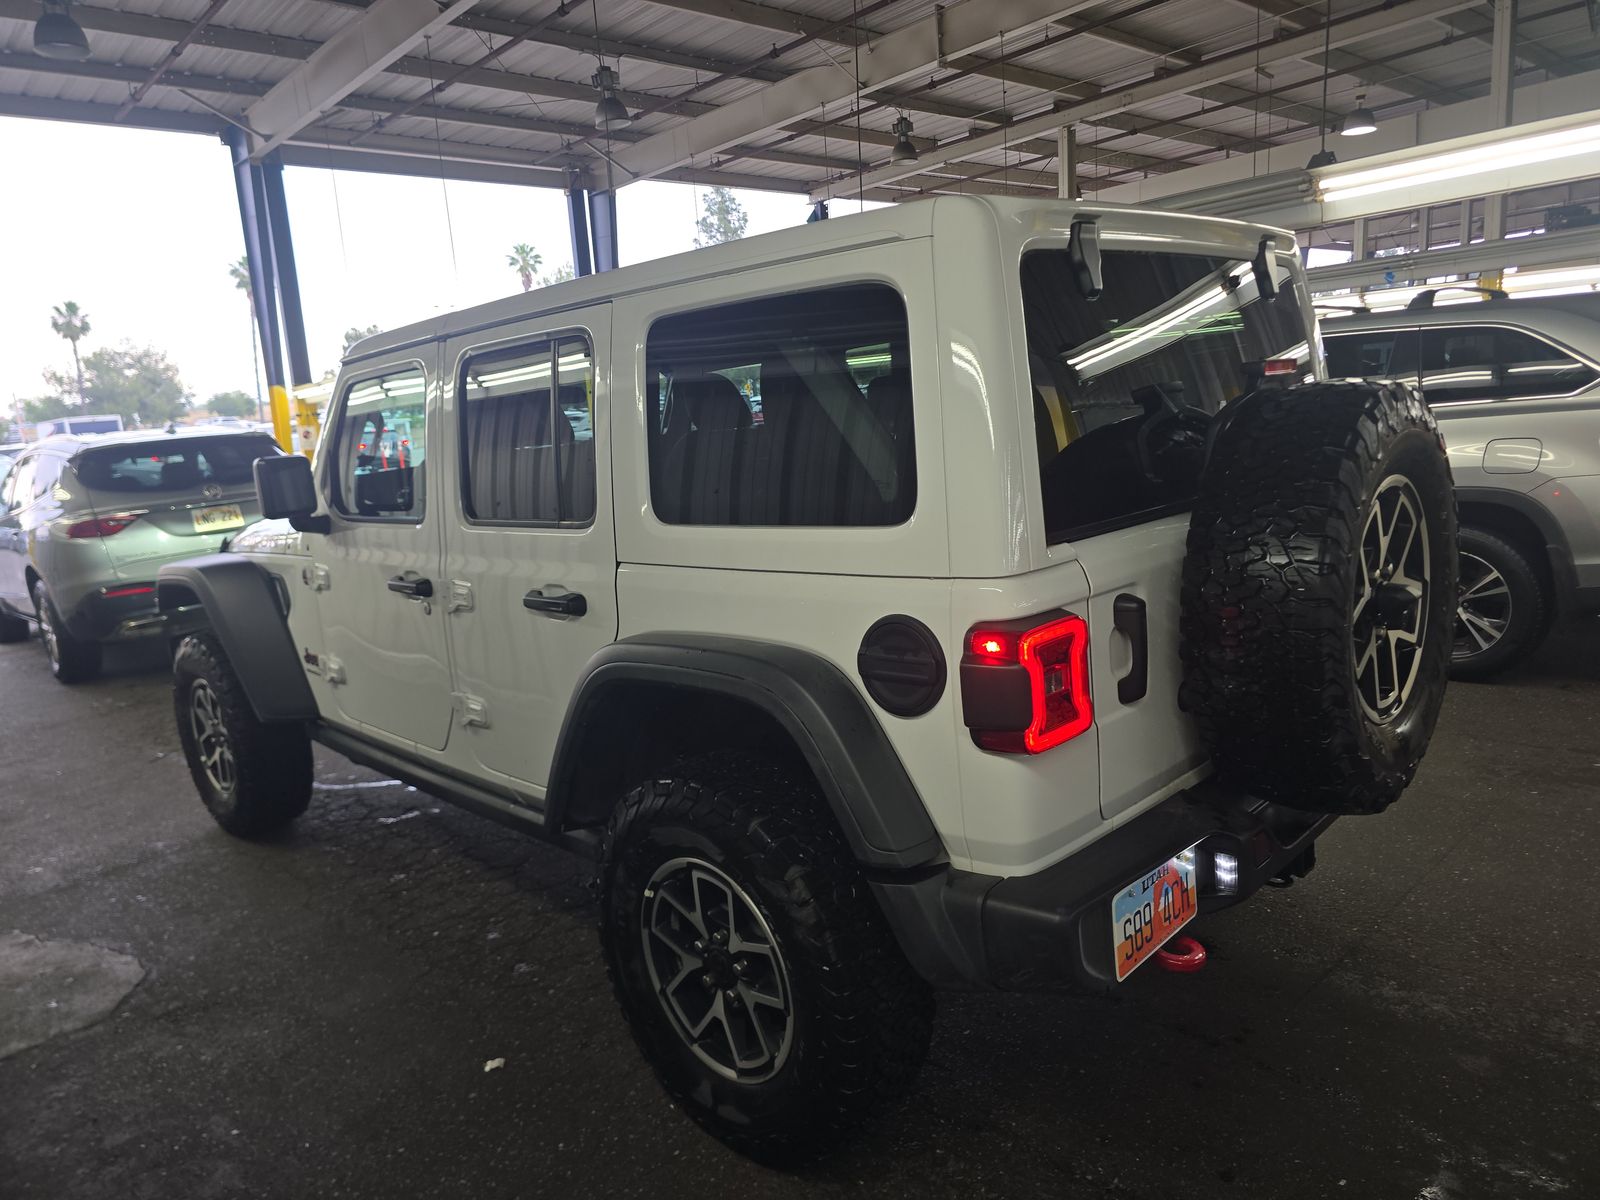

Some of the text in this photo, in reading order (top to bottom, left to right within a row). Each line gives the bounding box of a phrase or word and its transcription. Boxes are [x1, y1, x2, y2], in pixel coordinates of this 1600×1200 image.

[1141, 864, 1169, 894] UTAH
[1123, 902, 1153, 960] S89
[1163, 872, 1190, 925] 4CH
